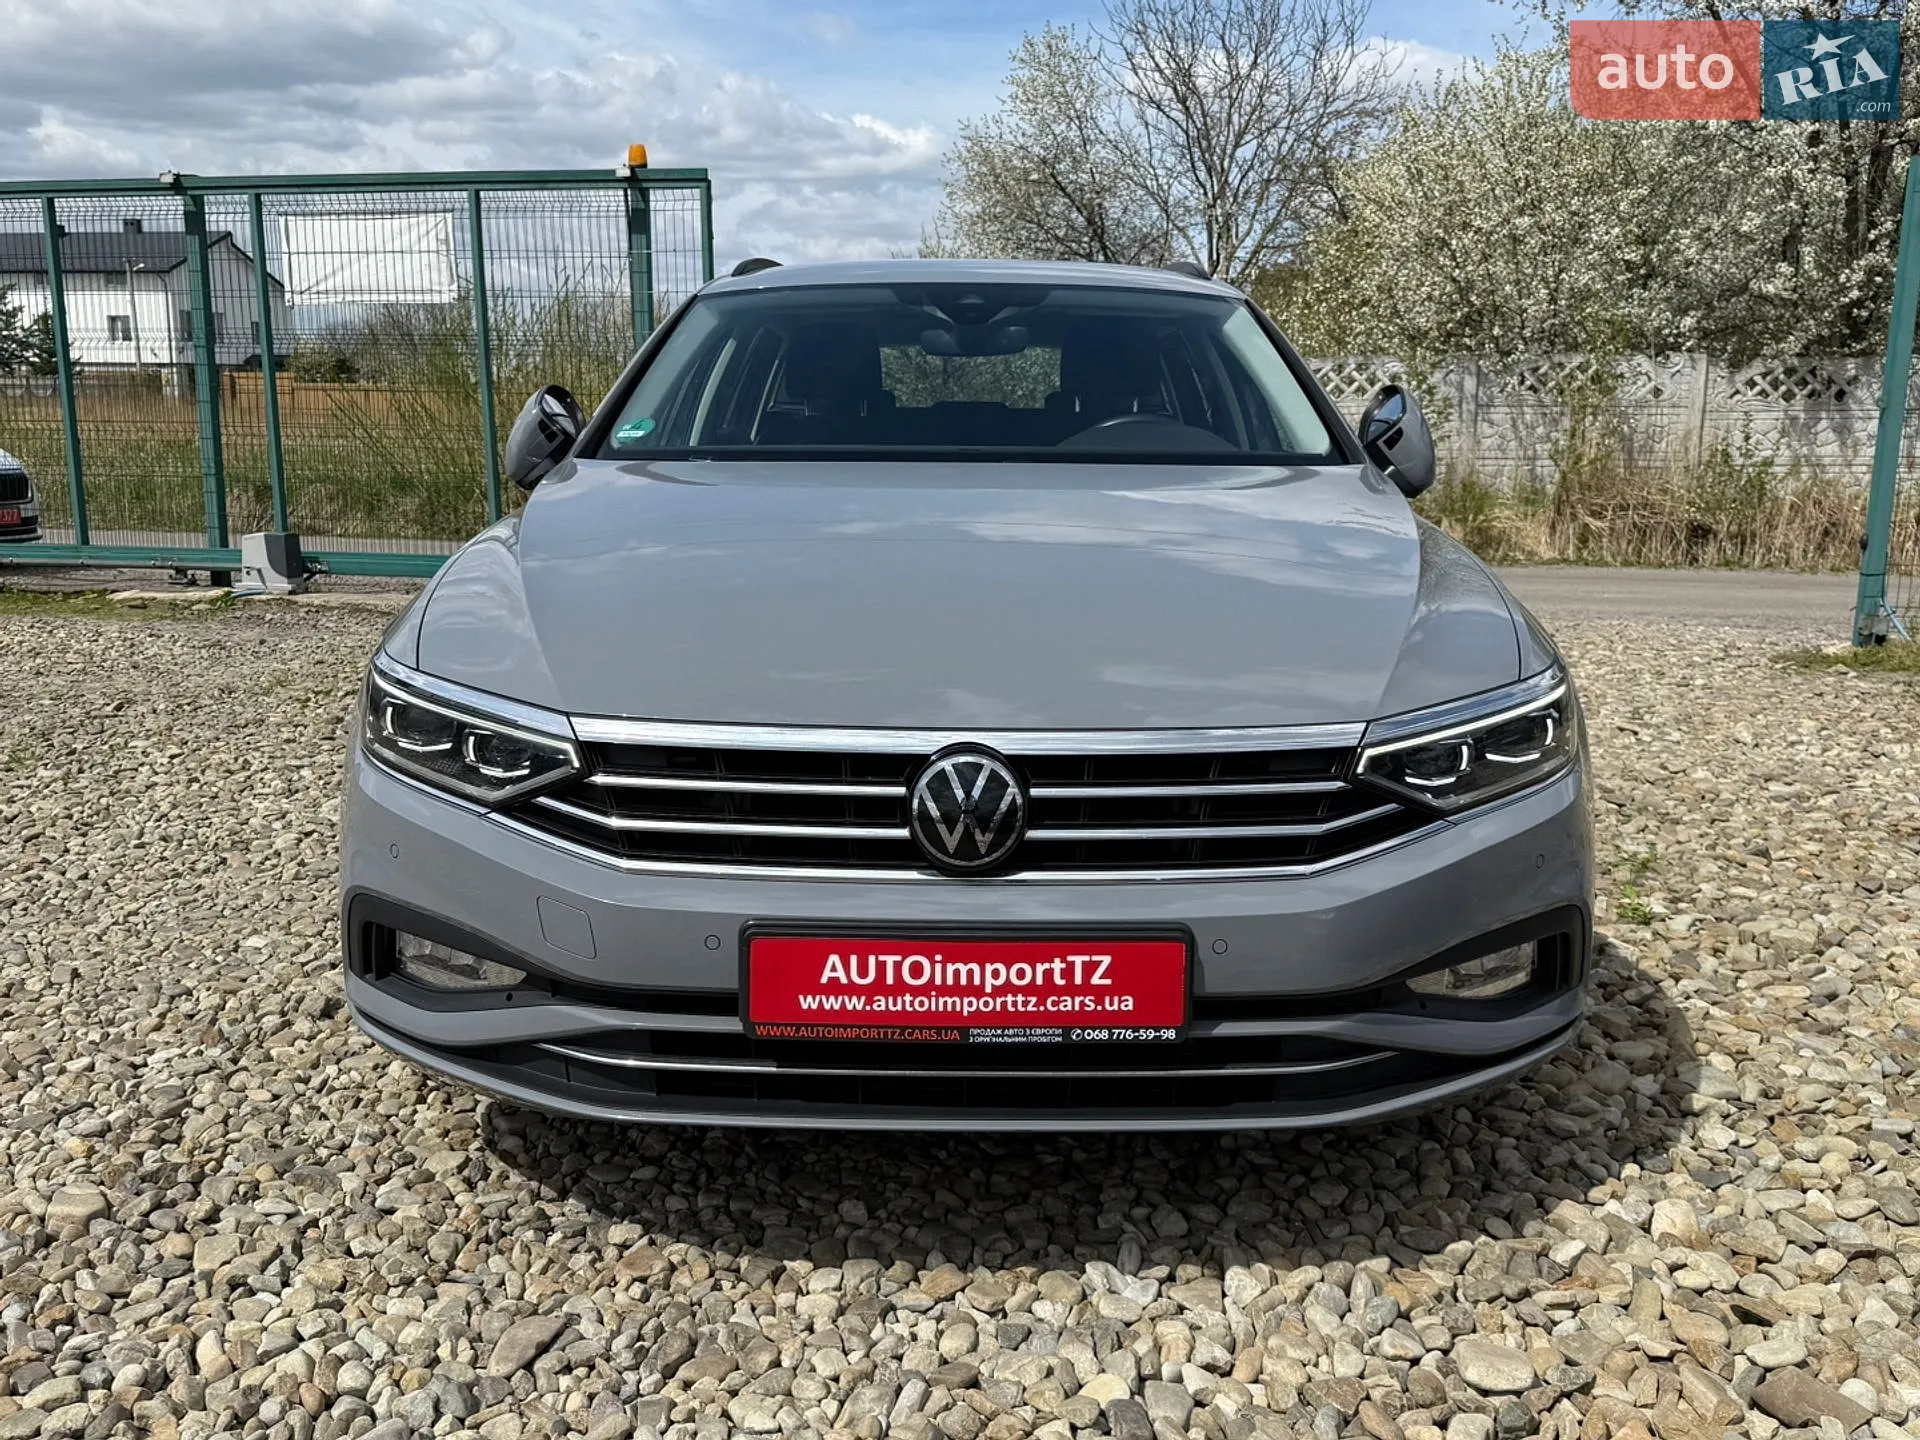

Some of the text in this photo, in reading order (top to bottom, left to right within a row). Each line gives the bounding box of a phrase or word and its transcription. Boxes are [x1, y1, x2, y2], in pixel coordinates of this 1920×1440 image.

[820, 954, 1112, 993] AUTOimportTZ
[798, 992, 1134, 1016] www.autoimporttz.cars.ua
[755, 1025, 960, 1041] WWW.AUTOIMPORTTZ.CARS.UA
[1084, 1029, 1176, 1040] 068 776-59-98
